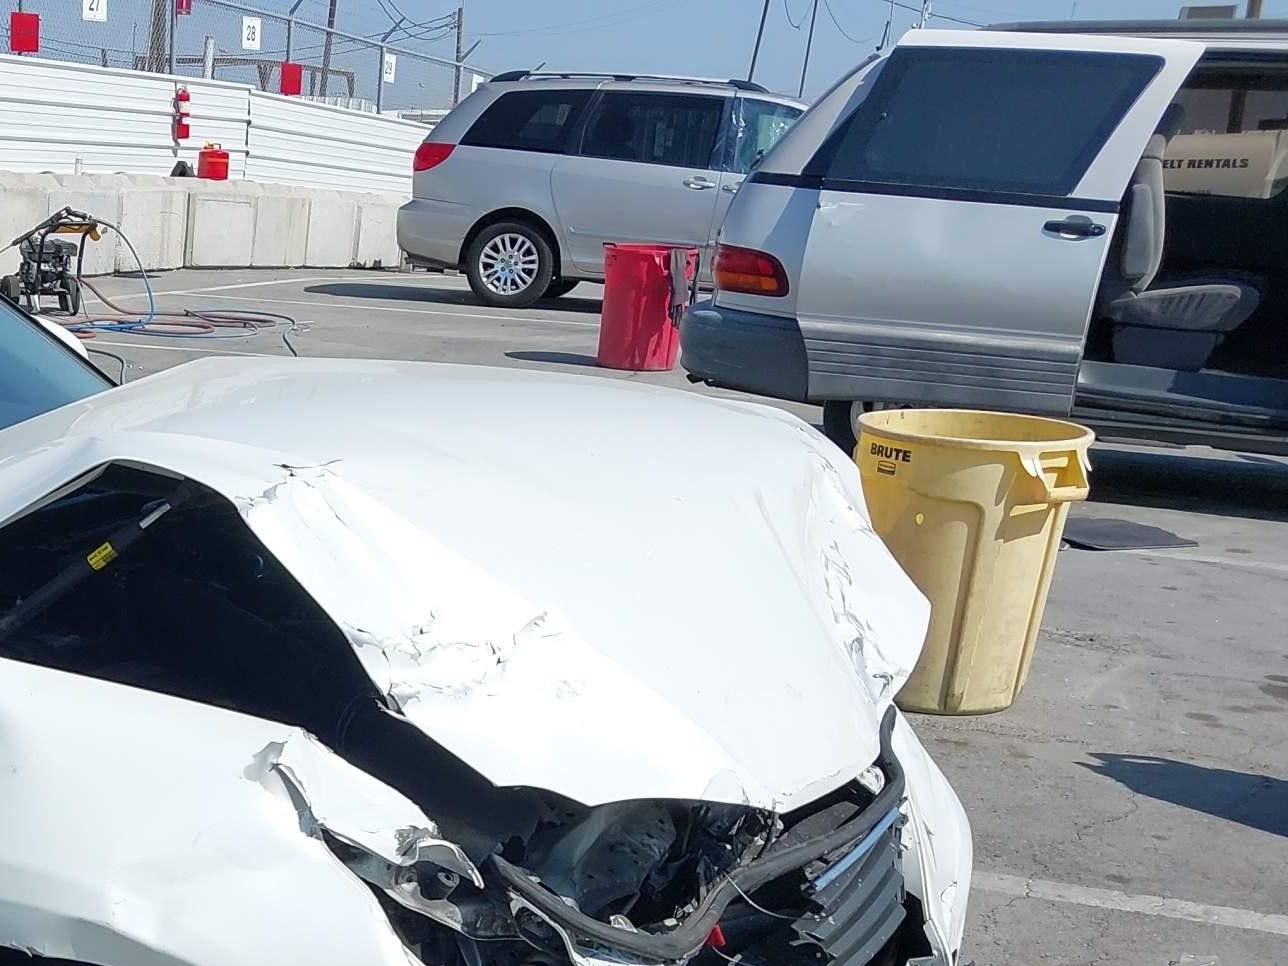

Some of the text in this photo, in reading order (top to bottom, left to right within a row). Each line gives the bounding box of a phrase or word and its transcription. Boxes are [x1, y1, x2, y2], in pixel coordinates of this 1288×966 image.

[247, 25, 256, 41] 28
[1187, 159, 1248, 168] RENTALS
[870, 442, 911, 462] BRUTE
